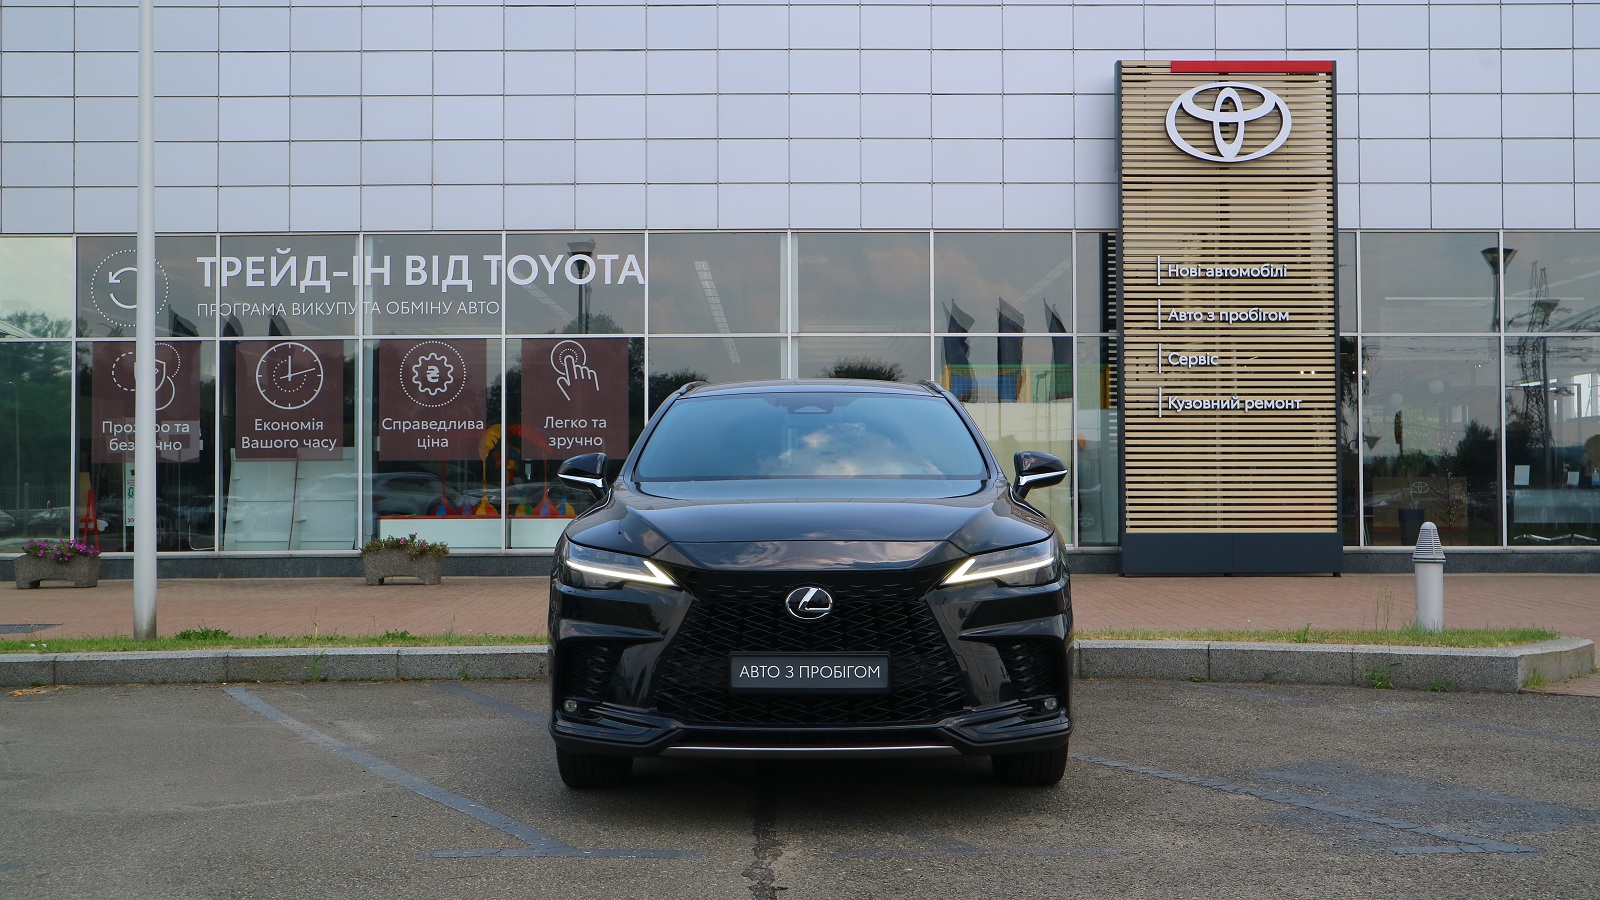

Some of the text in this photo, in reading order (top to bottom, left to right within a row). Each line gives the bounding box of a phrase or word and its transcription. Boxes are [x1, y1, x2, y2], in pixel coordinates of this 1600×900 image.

[196, 247, 645, 293] ТРЕЙД-ІН ВІД TOYOTA
[1168, 264, 1287, 278] Нові автомобілі
[197, 301, 500, 316] ПРОГРАМА ВИКУПУ ТА ОБМІНУ АВТО
[1168, 308, 1290, 324] Авто з пробігом
[1168, 352, 1219, 368] Сервіс
[1168, 395, 1302, 412] Кузовний ремонт
[174, 423, 190, 433] та
[254, 418, 323, 431] Економія
[382, 418, 484, 432] Справедлива
[544, 416, 607, 429] Легко та
[109, 438, 182, 451] безчно
[241, 437, 337, 451] Вашого часу
[417, 436, 449, 449] ціна
[548, 435, 603, 449] зручно
[739, 665, 880, 679] АВТО З ПРОБІГОМ
